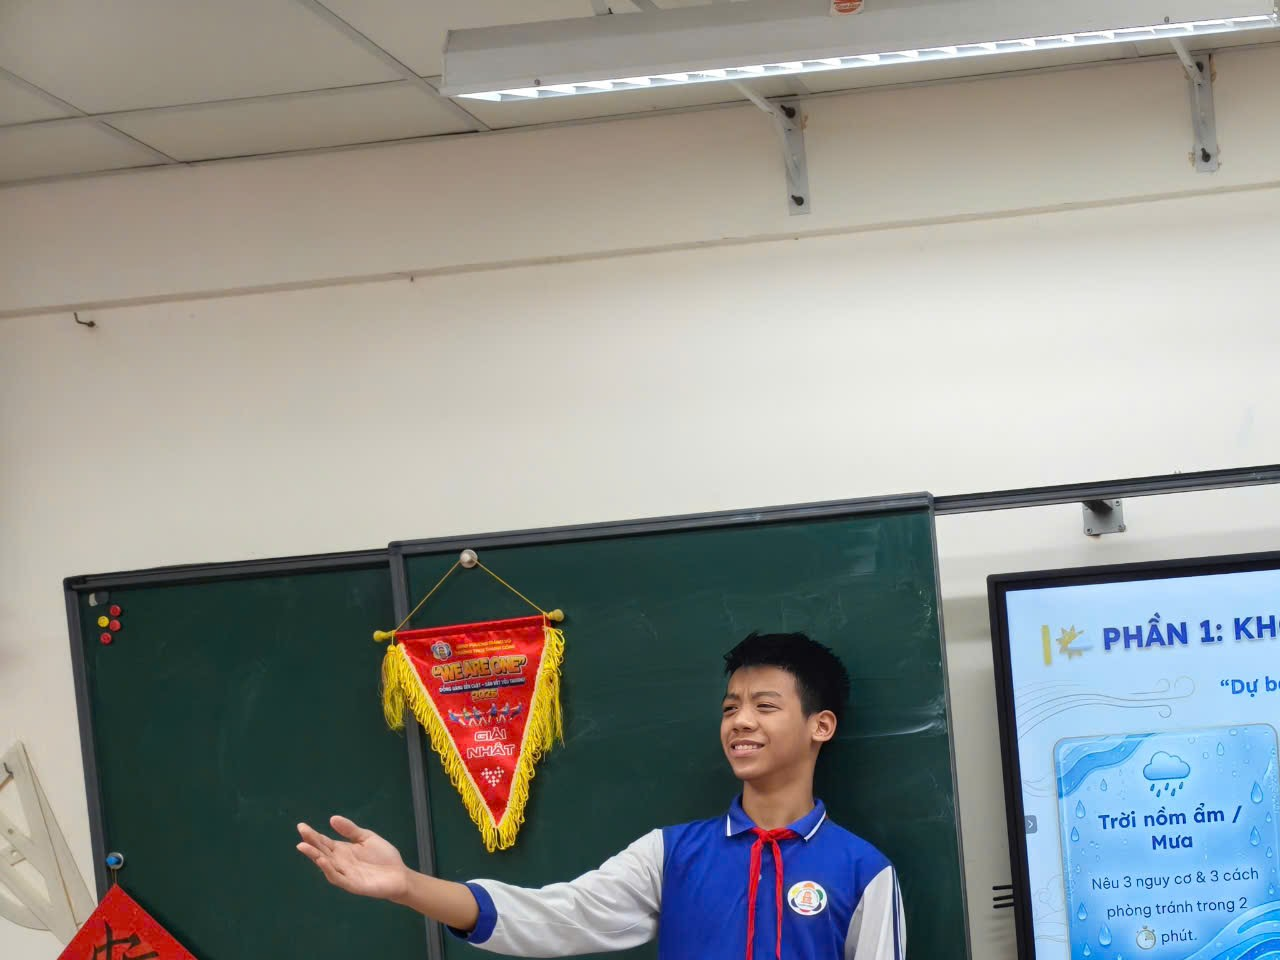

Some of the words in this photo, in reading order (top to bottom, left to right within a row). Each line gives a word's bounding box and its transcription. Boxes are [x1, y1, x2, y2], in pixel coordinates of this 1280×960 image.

[1103, 612, 1188, 650] PHẦN
[1200, 619, 1223, 643] 1:
[462, 657, 491, 678] ARE
[474, 727, 506, 741] GIẢI
[466, 742, 515, 759] NHẤT
[1098, 810, 1136, 830] Trời
[1144, 805, 1187, 827] nồm
[1193, 802, 1225, 823] ẩm
[1232, 805, 1242, 823] /
[1151, 834, 1193, 850] Mưa
[1091, 876, 1119, 890] Nêu
[1123, 875, 1132, 888] 3
[1136, 875, 1170, 889] nguy
[1174, 873, 1192, 885] cơ
[1196, 871, 1206, 883] &
[1210, 869, 1219, 882] 3
[1223, 867, 1259, 881] cách
[1107, 903, 1152, 920] phòng
[1155, 900, 1193, 915] tránh
[1196, 899, 1235, 913] trong
[1238, 896, 1248, 909] 2
[1161, 928, 1198, 945] phút.
